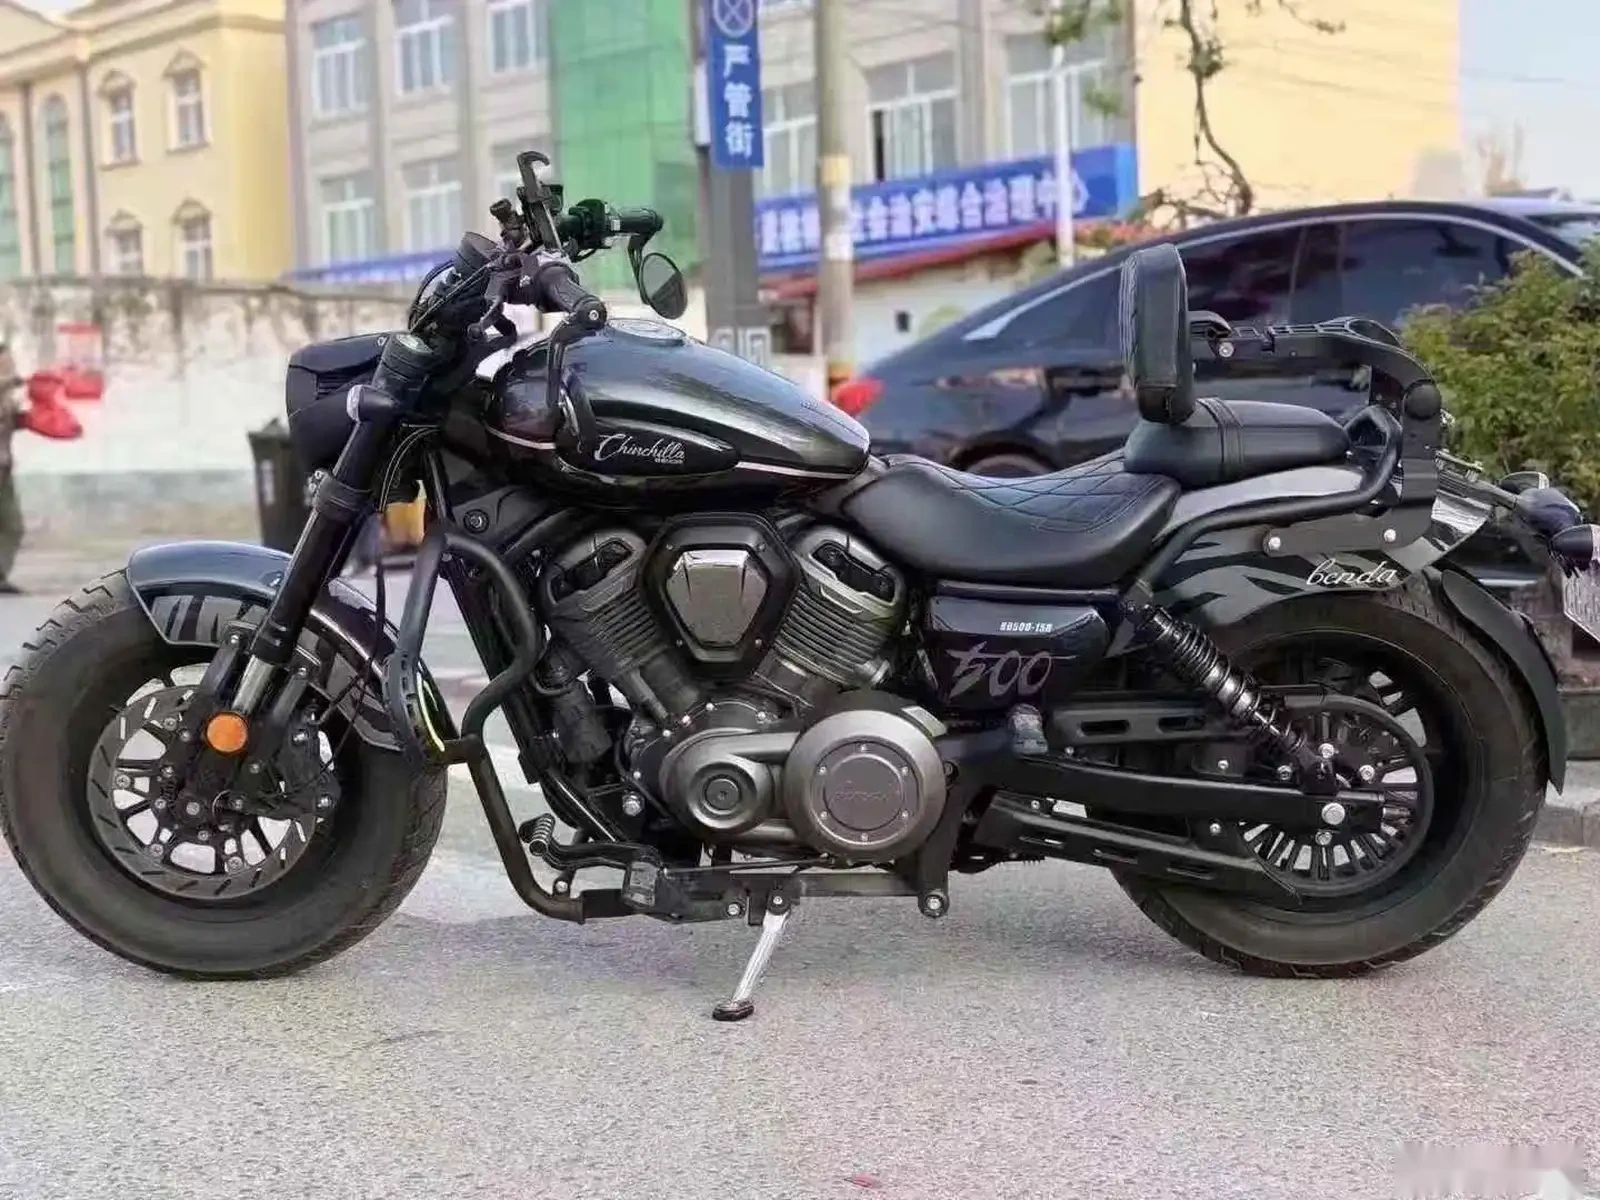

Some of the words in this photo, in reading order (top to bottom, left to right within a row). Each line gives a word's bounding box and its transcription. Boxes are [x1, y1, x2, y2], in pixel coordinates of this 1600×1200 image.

[723, 44, 754, 159] 严管街
[593, 433, 685, 461] Chinchilla
[946, 641, 1076, 698] 500
